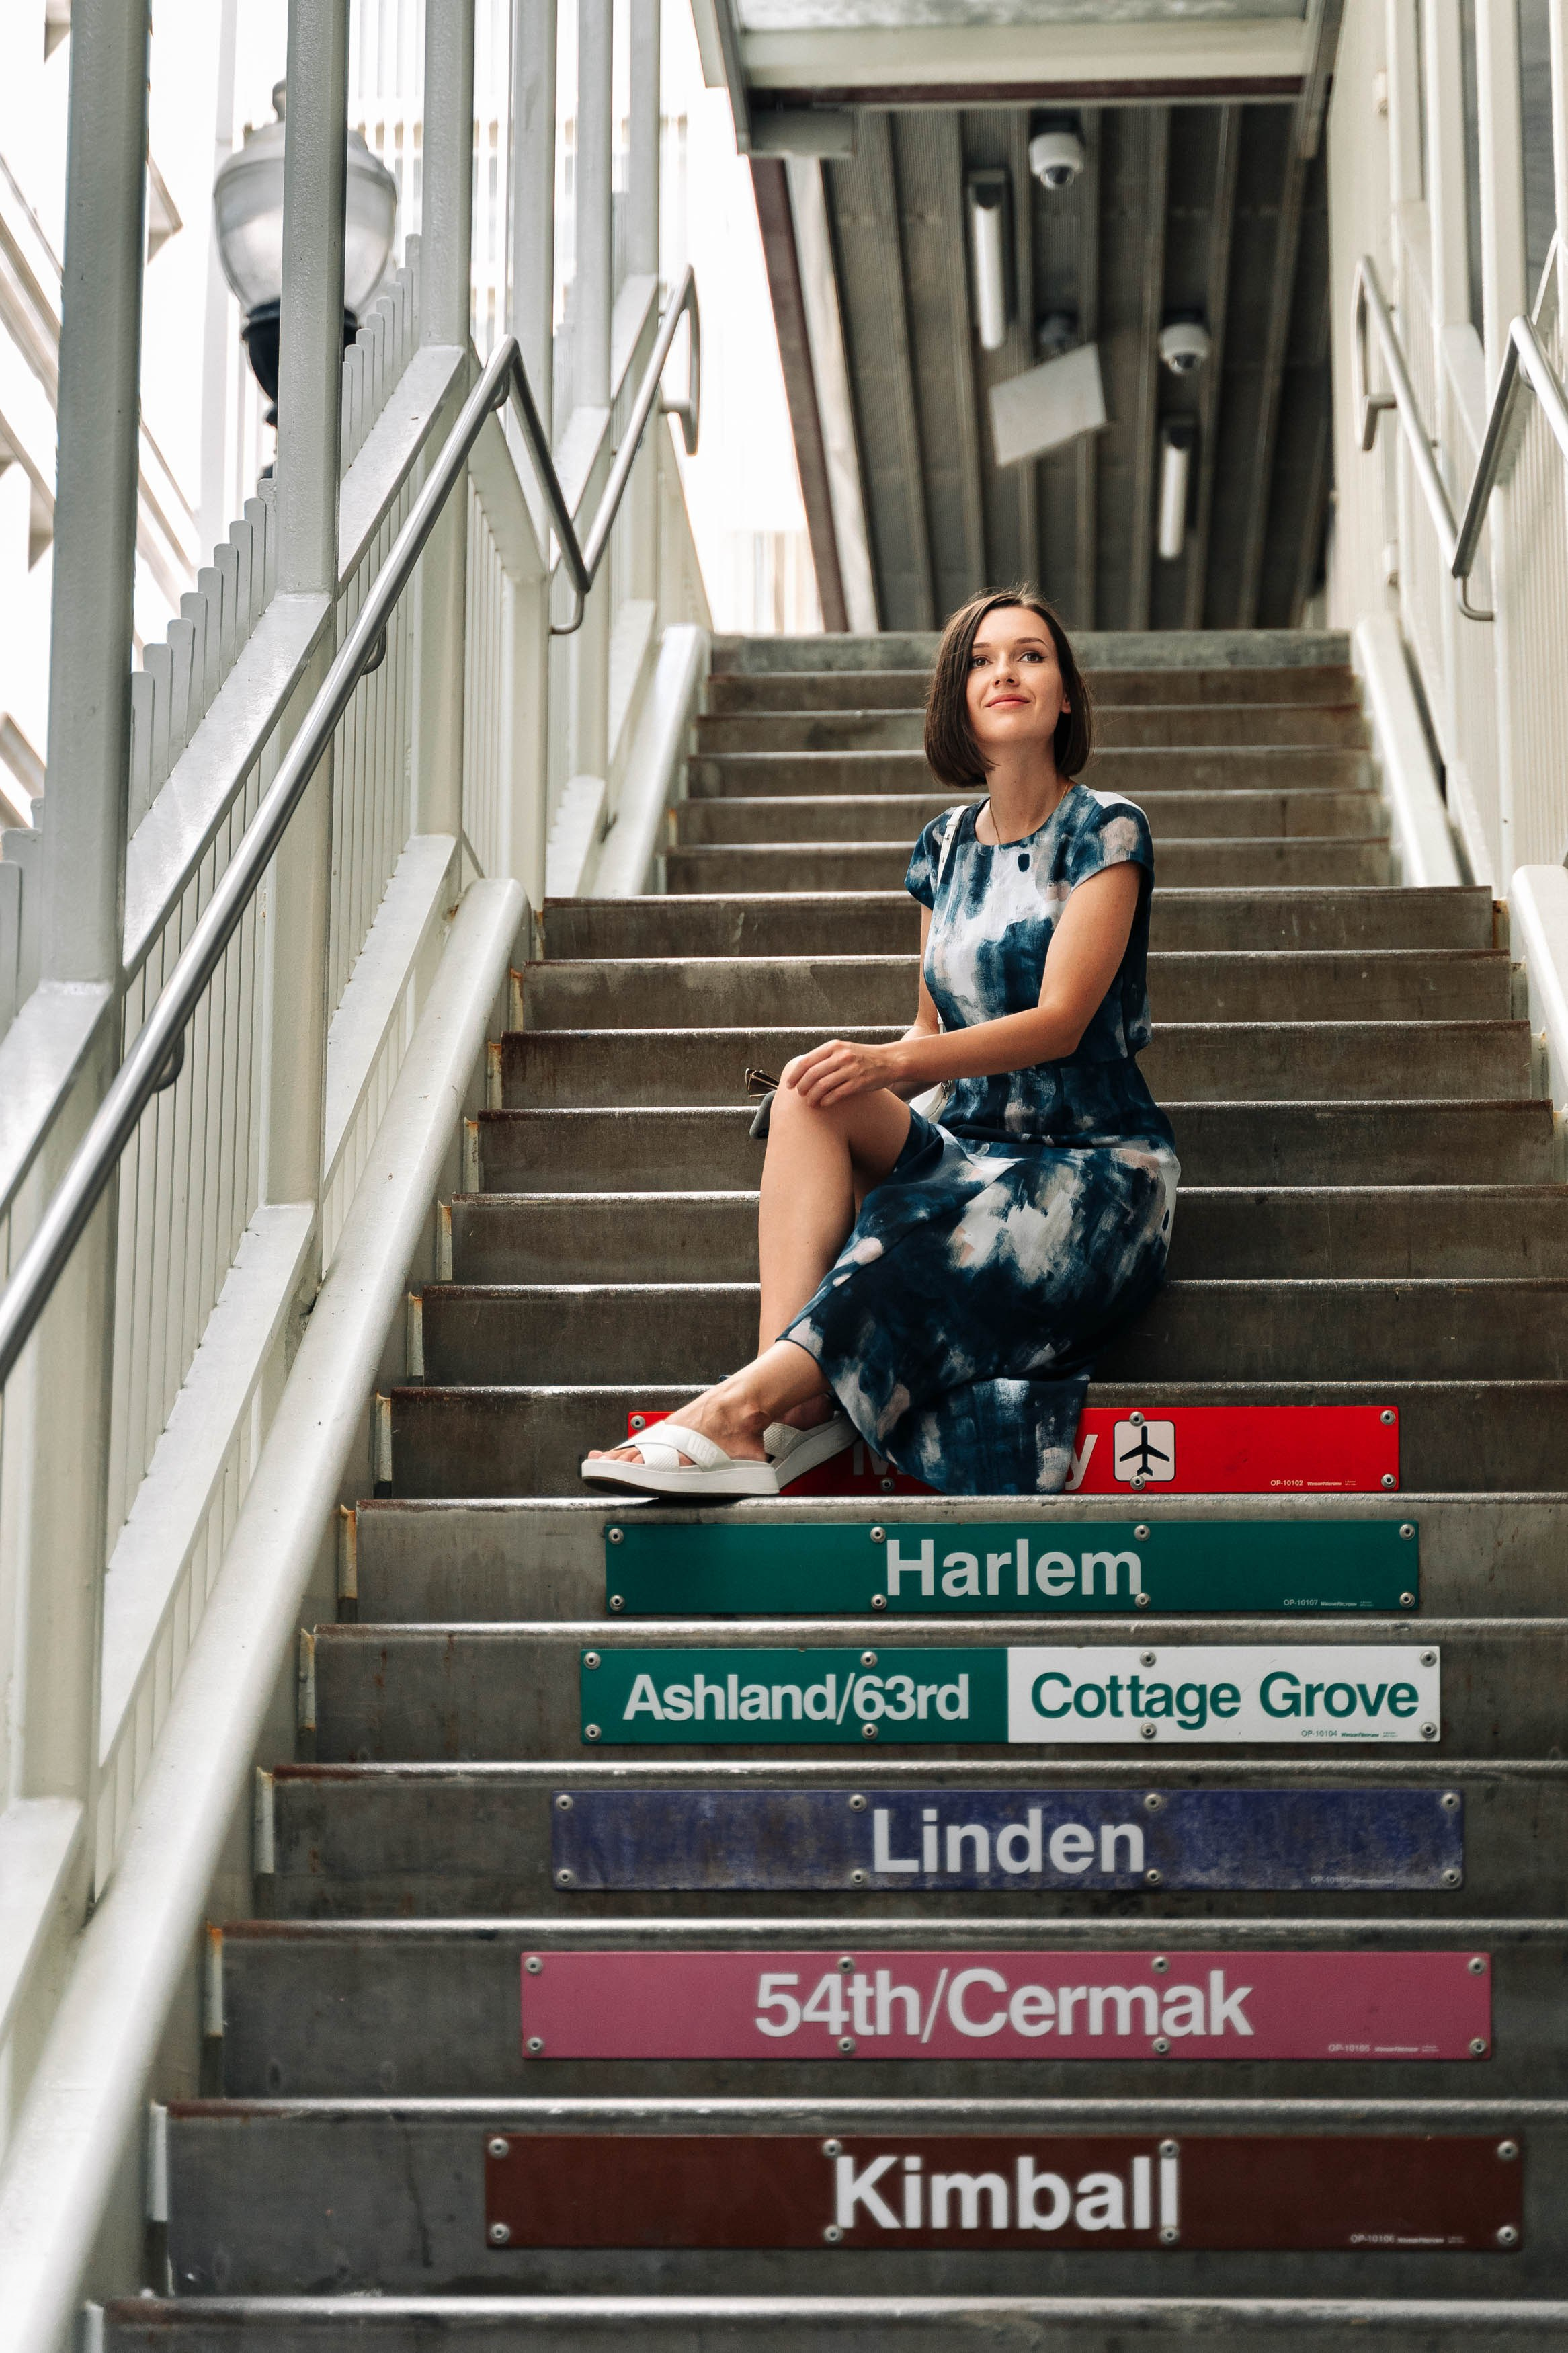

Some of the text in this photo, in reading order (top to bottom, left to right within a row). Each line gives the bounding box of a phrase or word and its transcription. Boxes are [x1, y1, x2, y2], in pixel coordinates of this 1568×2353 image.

[687, 1435, 718, 1466] UGG
[886, 1538, 1142, 1597] Harlem
[622, 1672, 970, 1724] Ashland/63rd
[1030, 1670, 1419, 1730] Cottage Grove
[872, 1808, 1145, 1874] Linden
[755, 1968, 1254, 2043] 54th/Cermak
[835, 2155, 1177, 2231] Kimball
